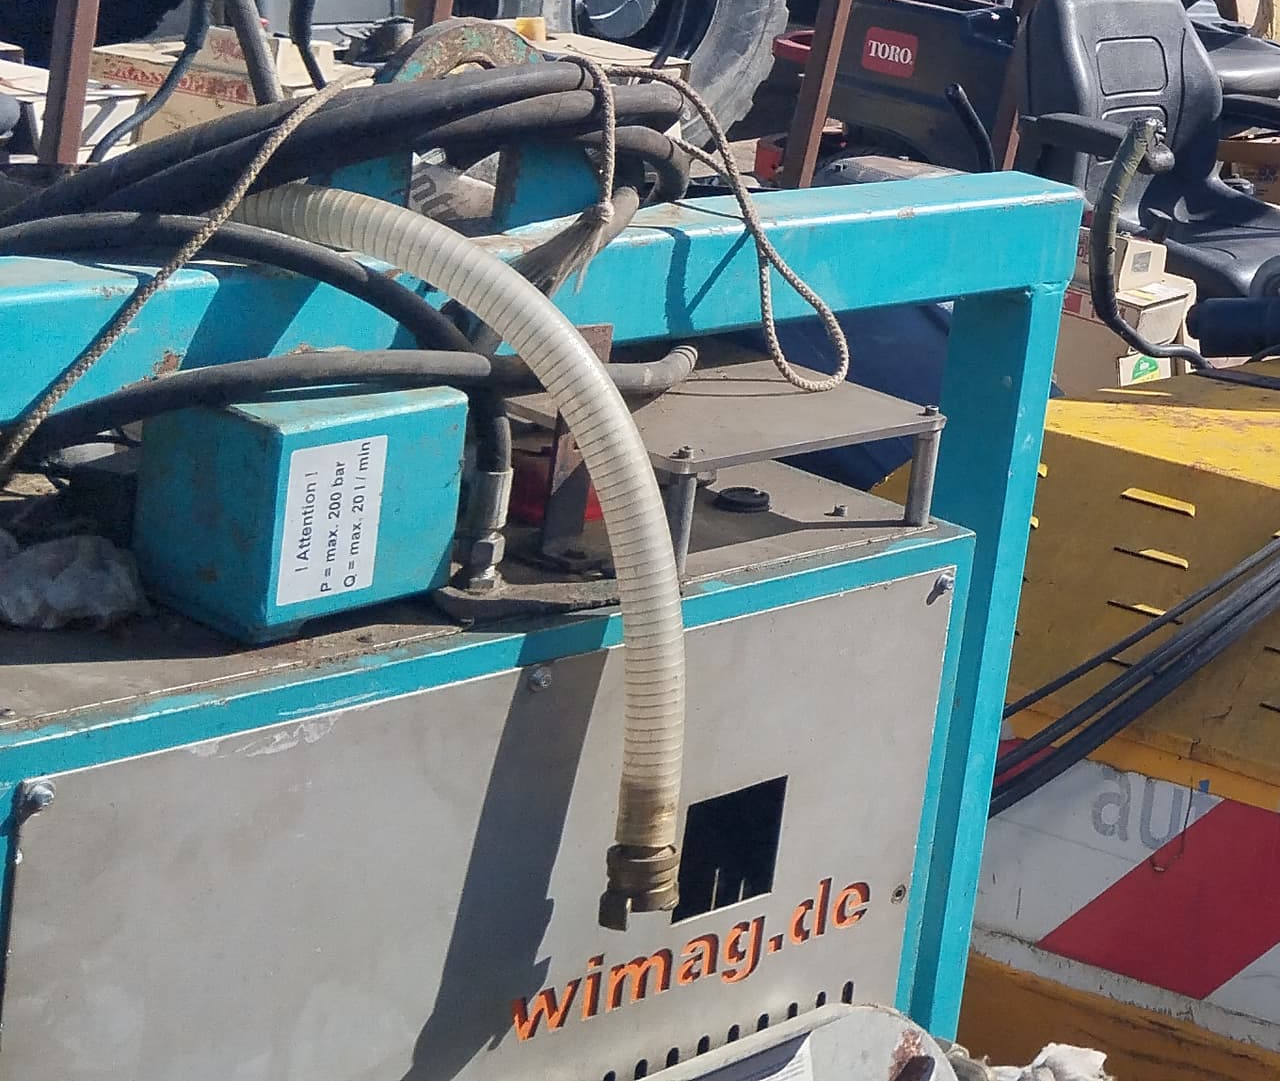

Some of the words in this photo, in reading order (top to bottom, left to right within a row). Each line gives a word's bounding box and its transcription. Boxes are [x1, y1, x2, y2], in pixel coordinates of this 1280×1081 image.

[358, 441, 372, 471] min
[332, 461, 346, 487] bar
[328, 491, 343, 520] 200
[352, 494, 365, 513] 20
[296, 482, 318, 562] Attention
[350, 517, 364, 555] max.
[326, 524, 339, 563] max.
[320, 581, 333, 593] P
[343, 574, 358, 588] Q
[510, 877, 872, 1041] wimag.de
